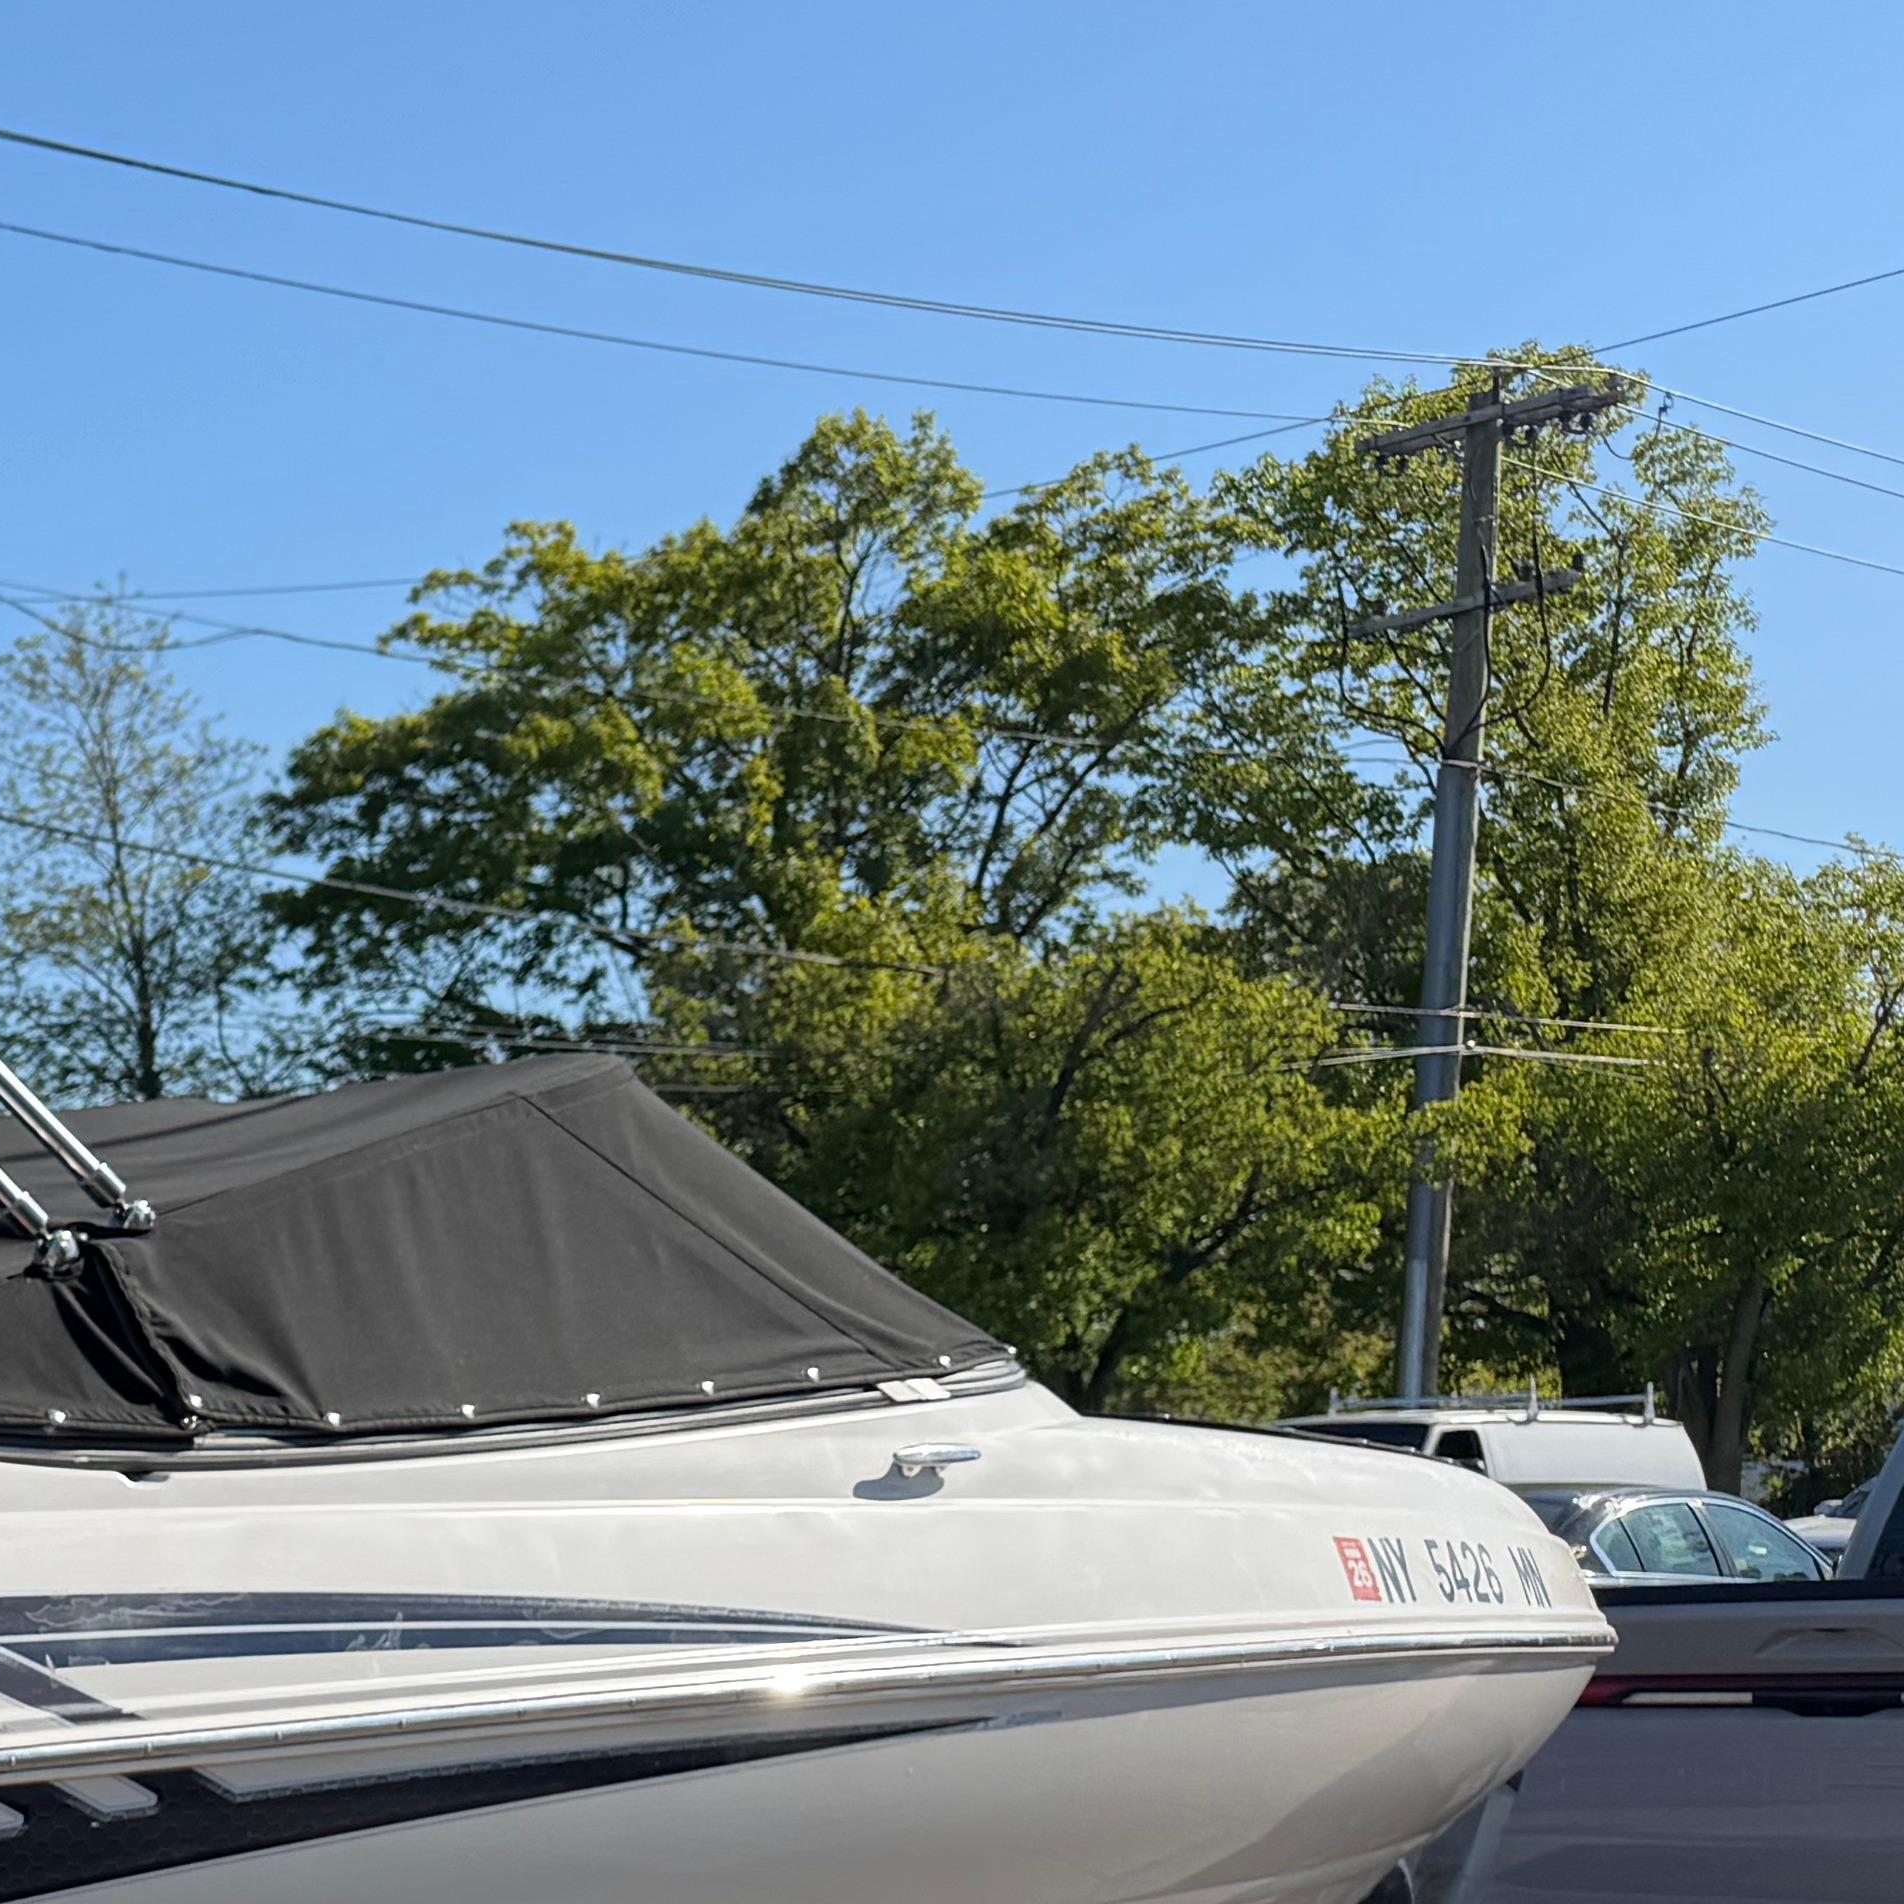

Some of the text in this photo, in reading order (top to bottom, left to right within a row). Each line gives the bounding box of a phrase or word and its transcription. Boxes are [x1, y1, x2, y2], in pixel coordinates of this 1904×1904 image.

[1347, 1558, 1373, 1588] 26
[1368, 1538, 1552, 1608] NY 5426 MN
